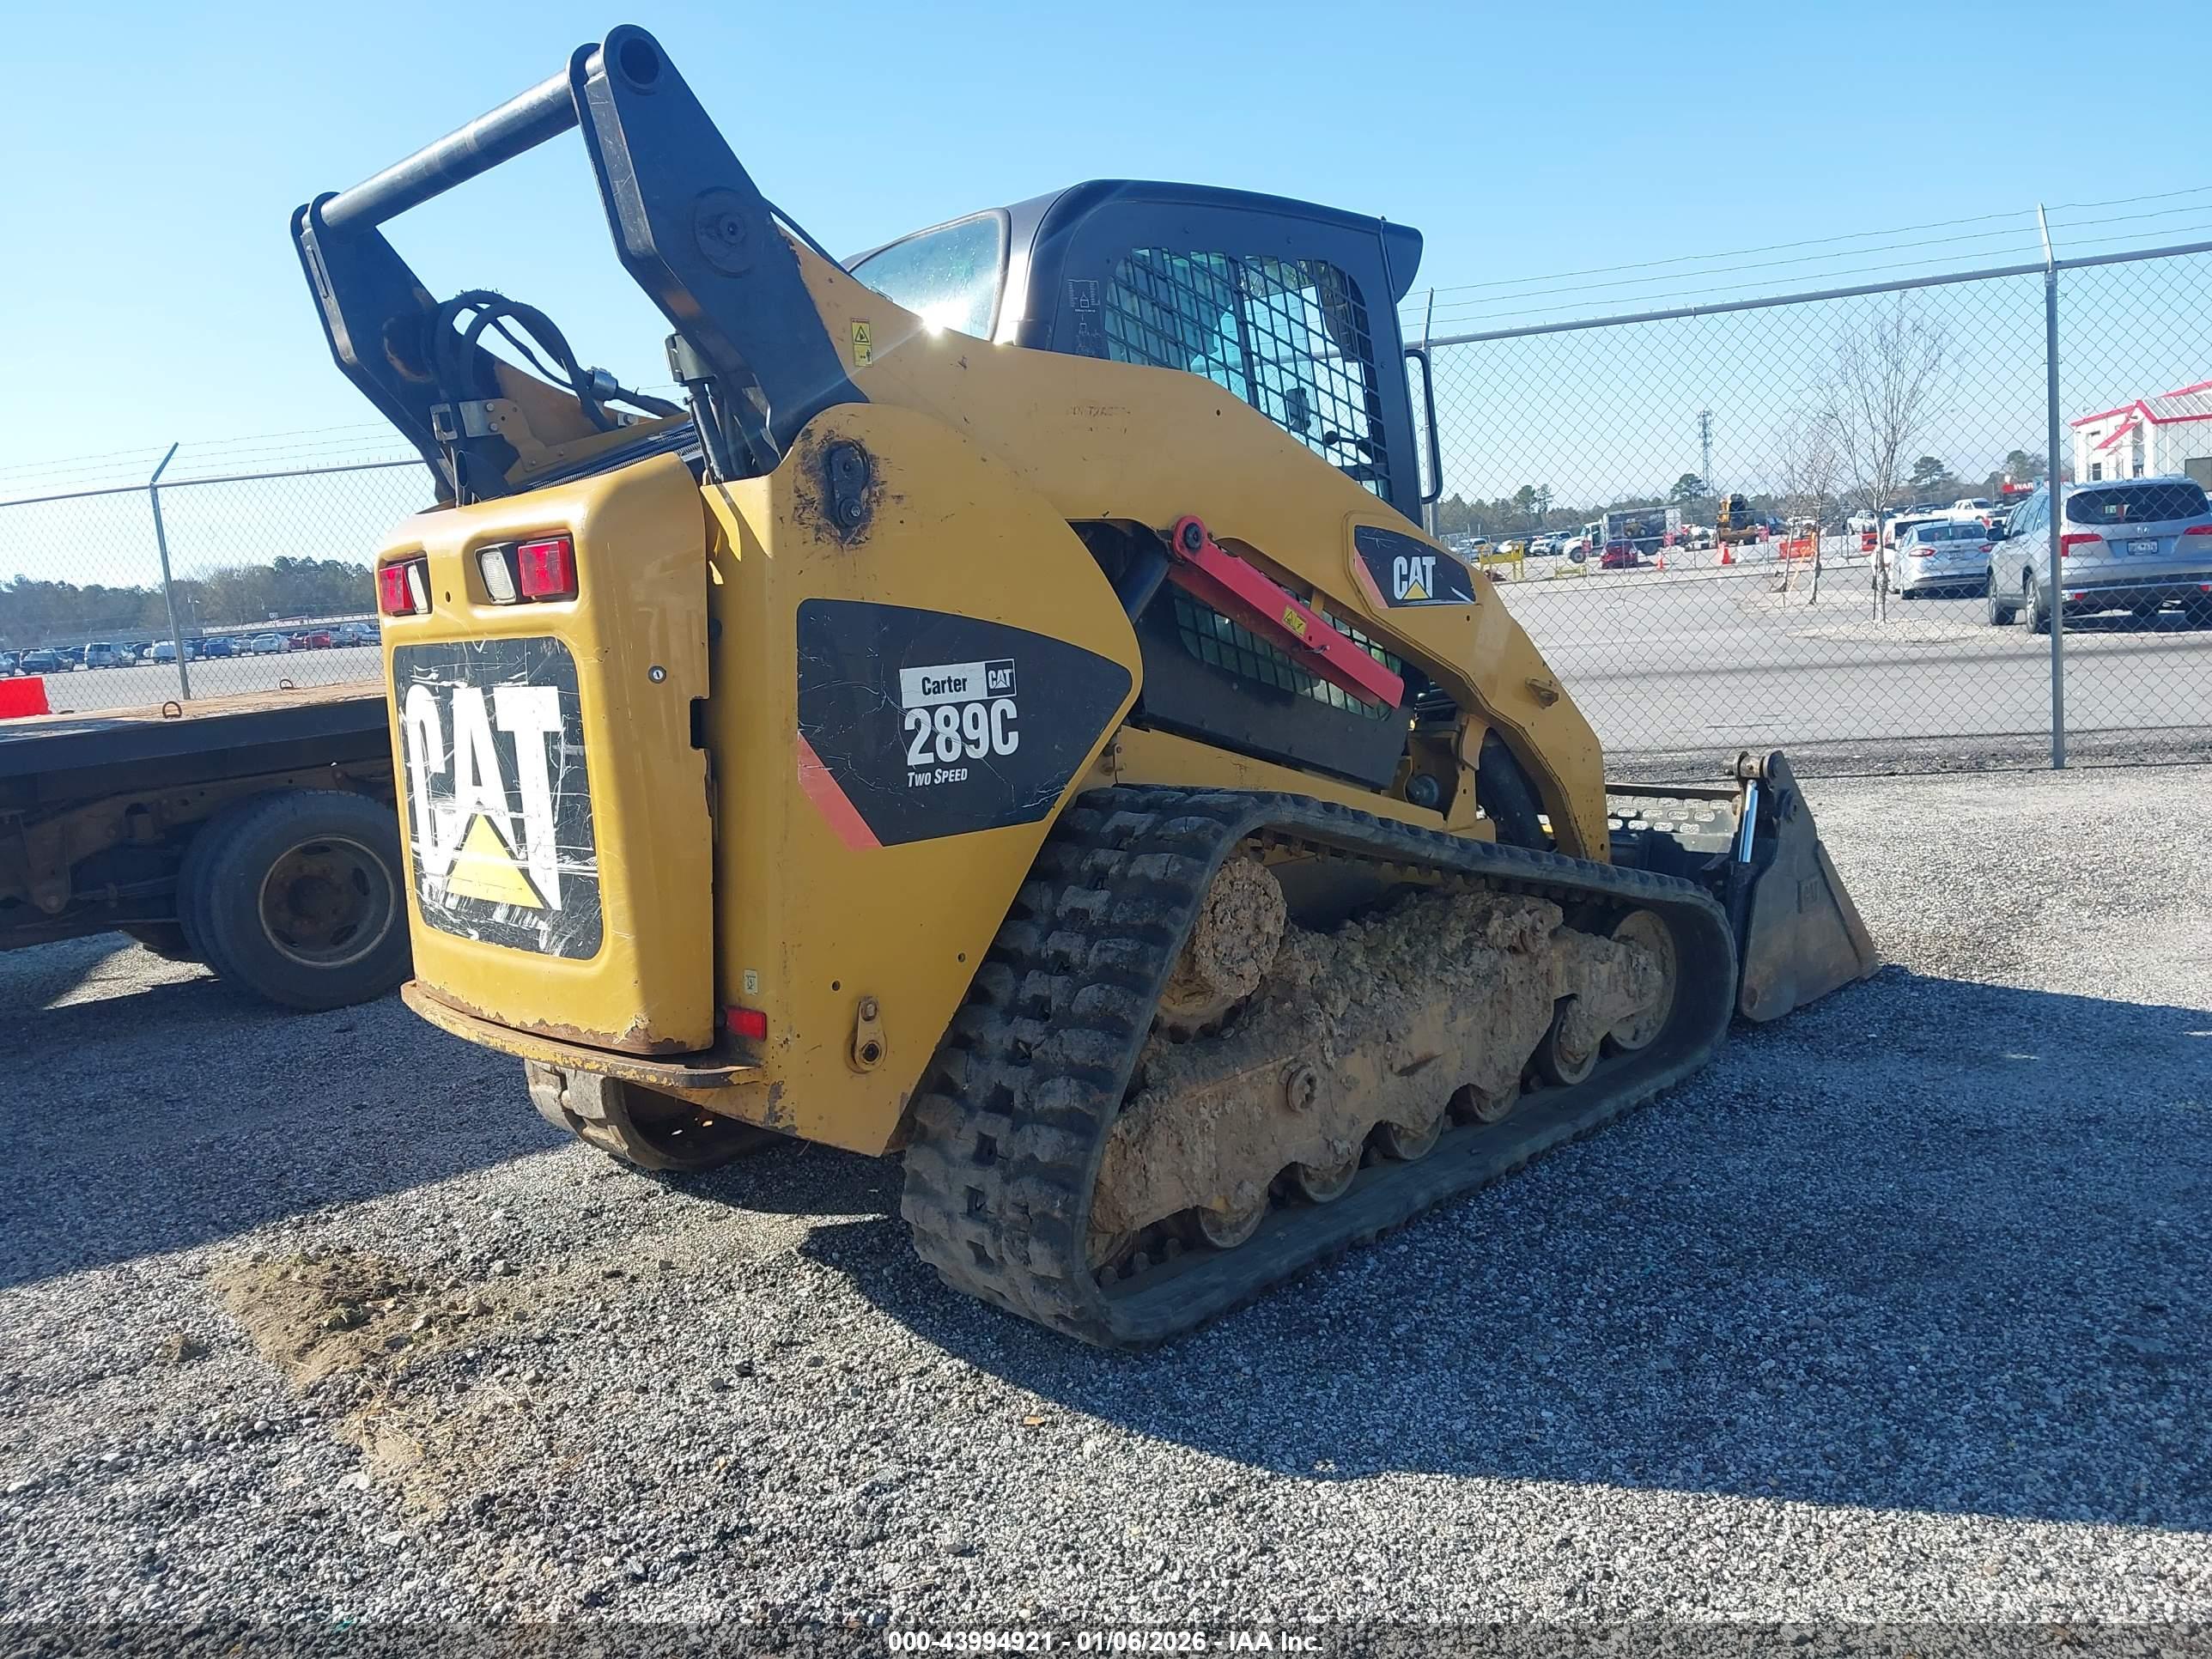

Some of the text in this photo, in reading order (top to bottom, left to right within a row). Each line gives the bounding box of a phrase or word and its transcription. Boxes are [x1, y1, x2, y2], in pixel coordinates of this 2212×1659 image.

[1393, 556, 1437, 600] CAT
[921, 676, 968, 696] Carter
[988, 668, 1013, 690] CAT
[904, 698, 1019, 766] 289C
[404, 684, 563, 911] CAT
